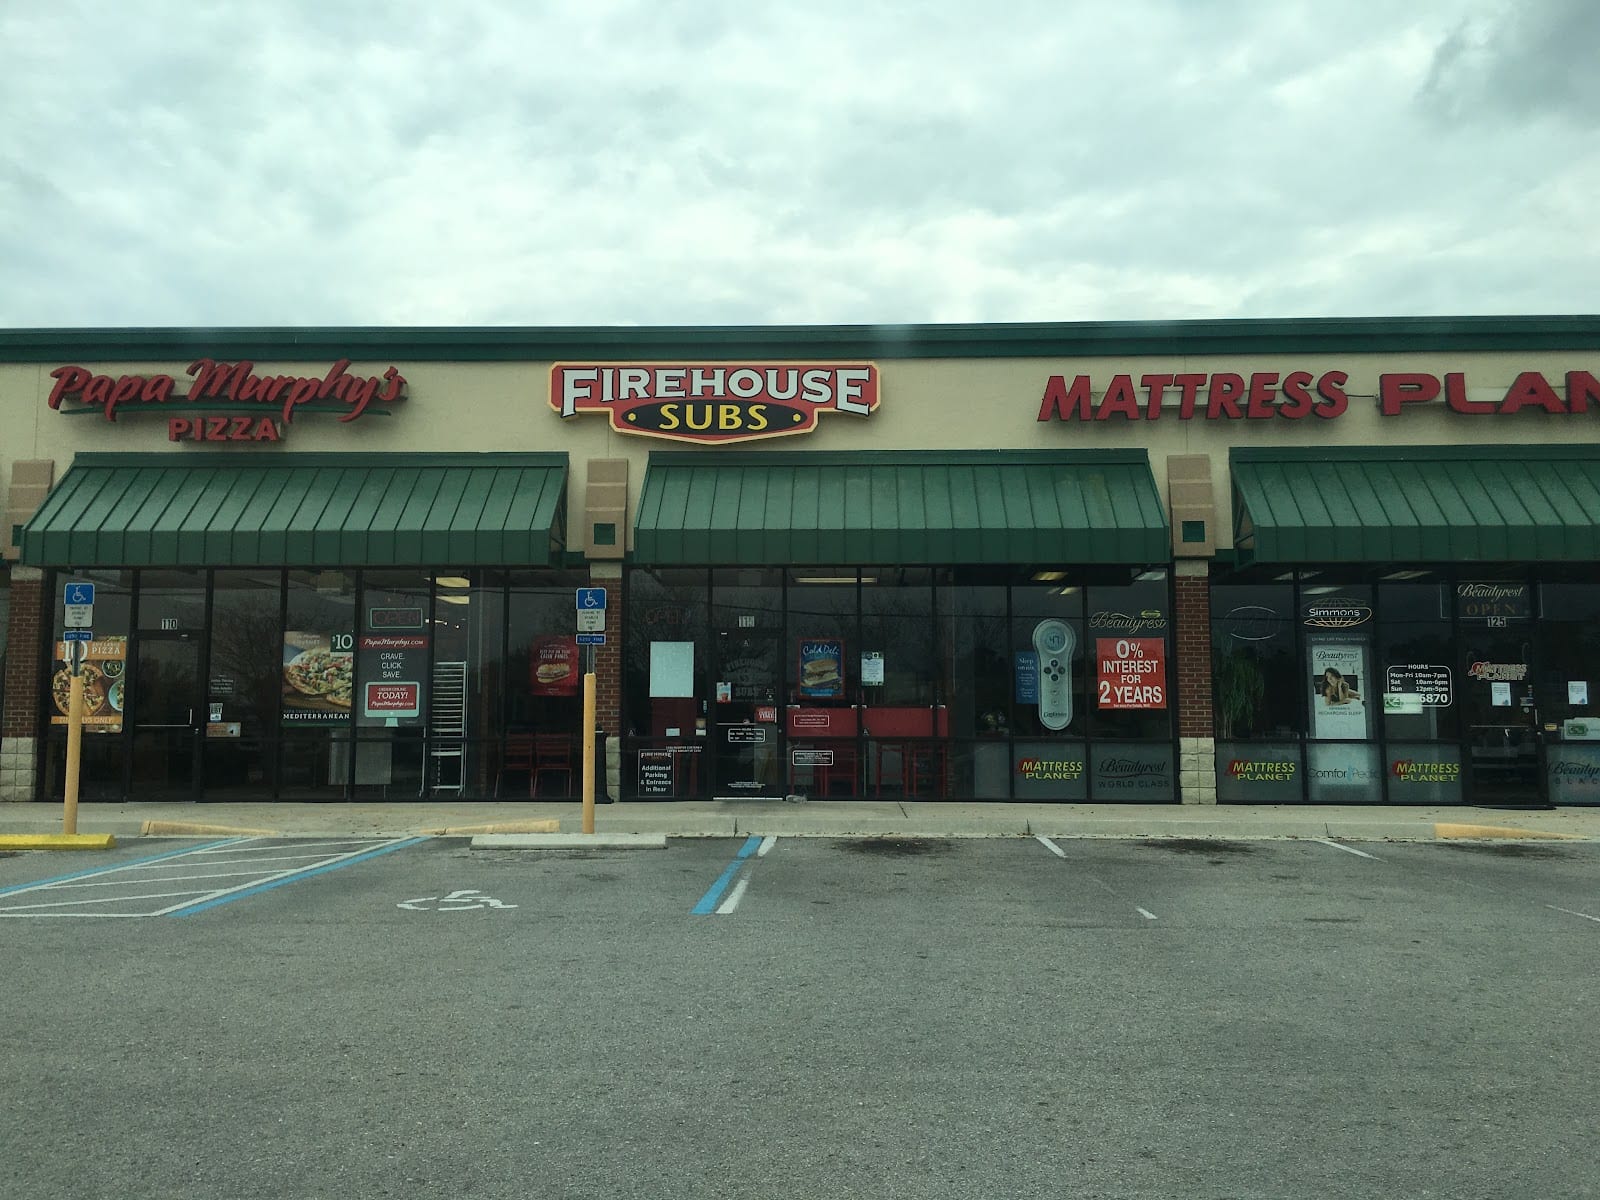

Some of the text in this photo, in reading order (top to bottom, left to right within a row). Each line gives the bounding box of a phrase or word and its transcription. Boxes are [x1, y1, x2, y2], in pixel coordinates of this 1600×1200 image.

[48, 358, 409, 422] Papa Murphy's
[561, 367, 871, 418] FIREHOUSE
[1037, 370, 1349, 421] MATTRESS
[659, 404, 768, 430] SUBS
[169, 417, 280, 441] PIZZA
[1457, 583, 1524, 603] Beautyrest
[1308, 608, 1361, 617] Simmons
[1466, 603, 1517, 616] OPEN
[1089, 611, 1168, 635] Beautyrest
[1488, 616, 1506, 628] 125
[331, 634, 353, 650] $10
[92, 647, 121, 655] PIZZA
[802, 645, 839, 656] Cold Deli
[1117, 640, 1144, 659] 0%
[1315, 651, 1358, 661] Beautyrest
[1103, 661, 1159, 673] INTEREST
[1121, 675, 1142, 684] FOR
[377, 691, 408, 700] TODAY!
[1099, 681, 1163, 704] 2 YEARS
[1022, 761, 1083, 772] MATTRESS
[1099, 759, 1166, 775] Beautyrest
[1232, 762, 1296, 773] MATTRESS
[1396, 763, 1460, 774] MATTRESS
[1025, 772, 1080, 780] PLANET
[1237, 773, 1293, 781] PLANET
[1400, 774, 1458, 782] PLANET
